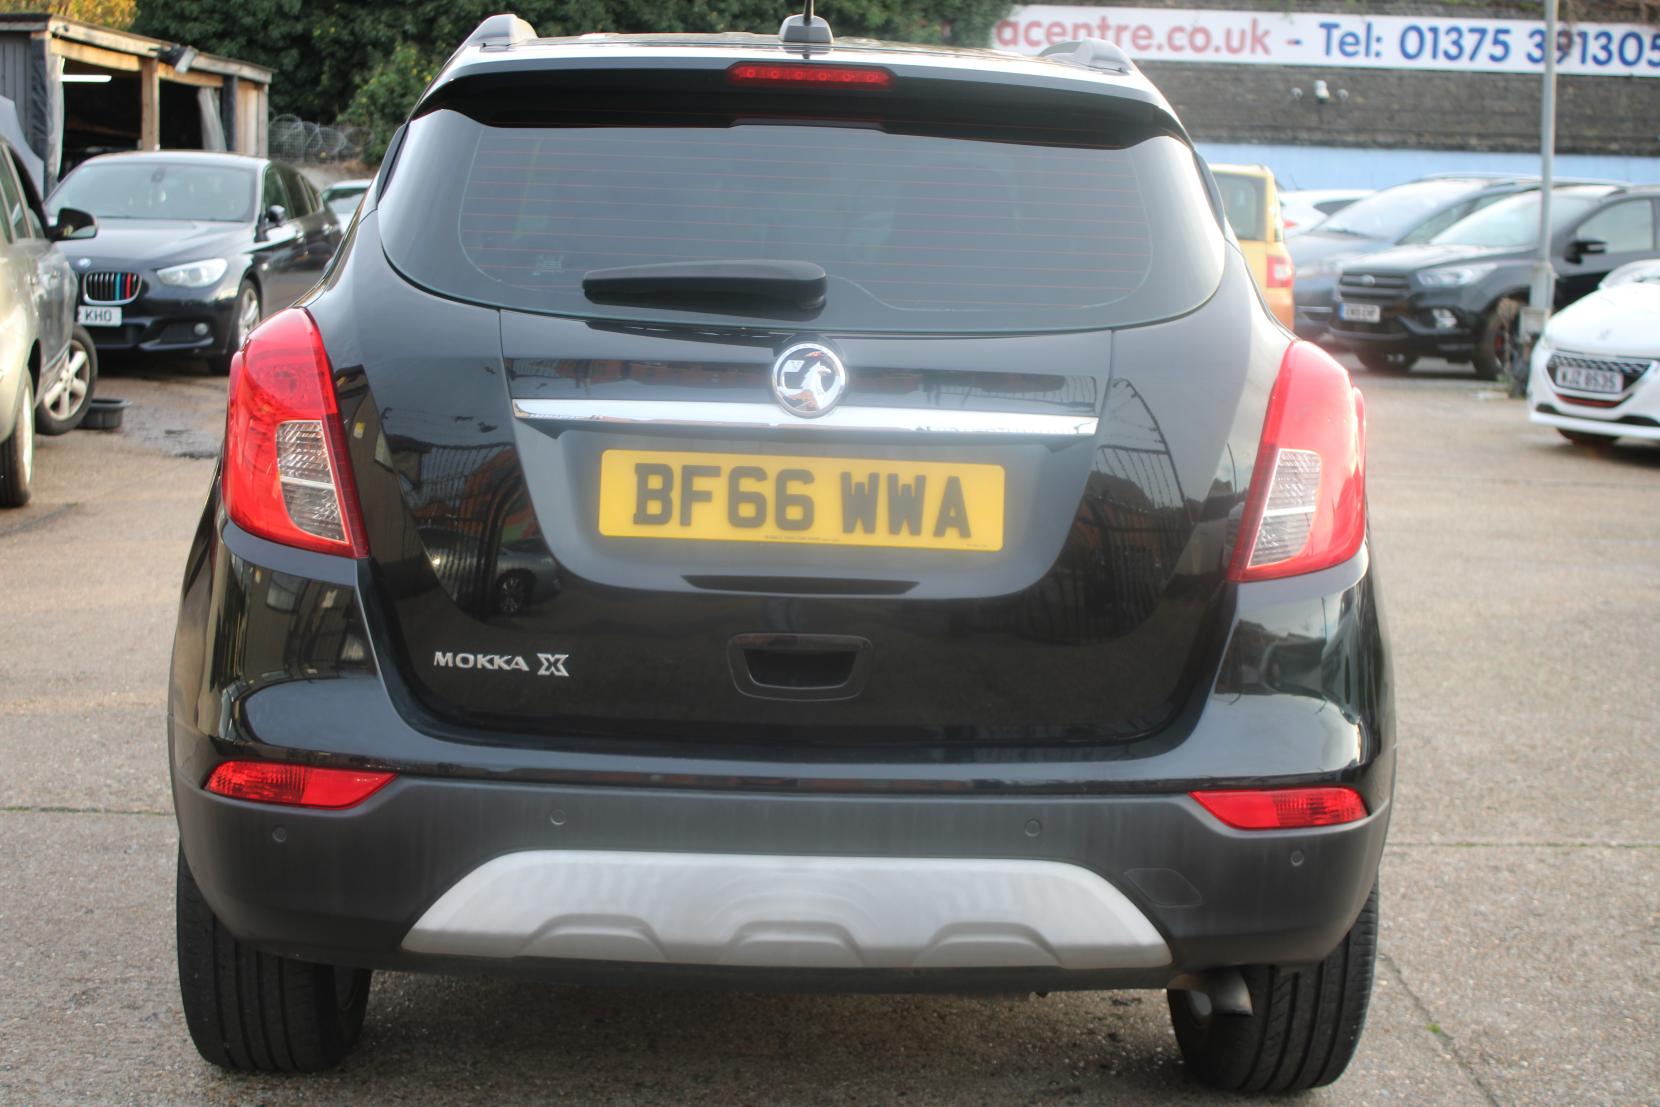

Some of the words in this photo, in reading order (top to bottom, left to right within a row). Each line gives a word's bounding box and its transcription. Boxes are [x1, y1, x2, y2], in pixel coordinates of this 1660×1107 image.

[1319, 22, 1383, 58] Tel:
[1400, 24, 1511, 62] 01375
[633, 462, 815, 531] BF66
[840, 471, 972, 538] WWA
[433, 651, 530, 671] MOKKA
[537, 653, 570, 677] X
